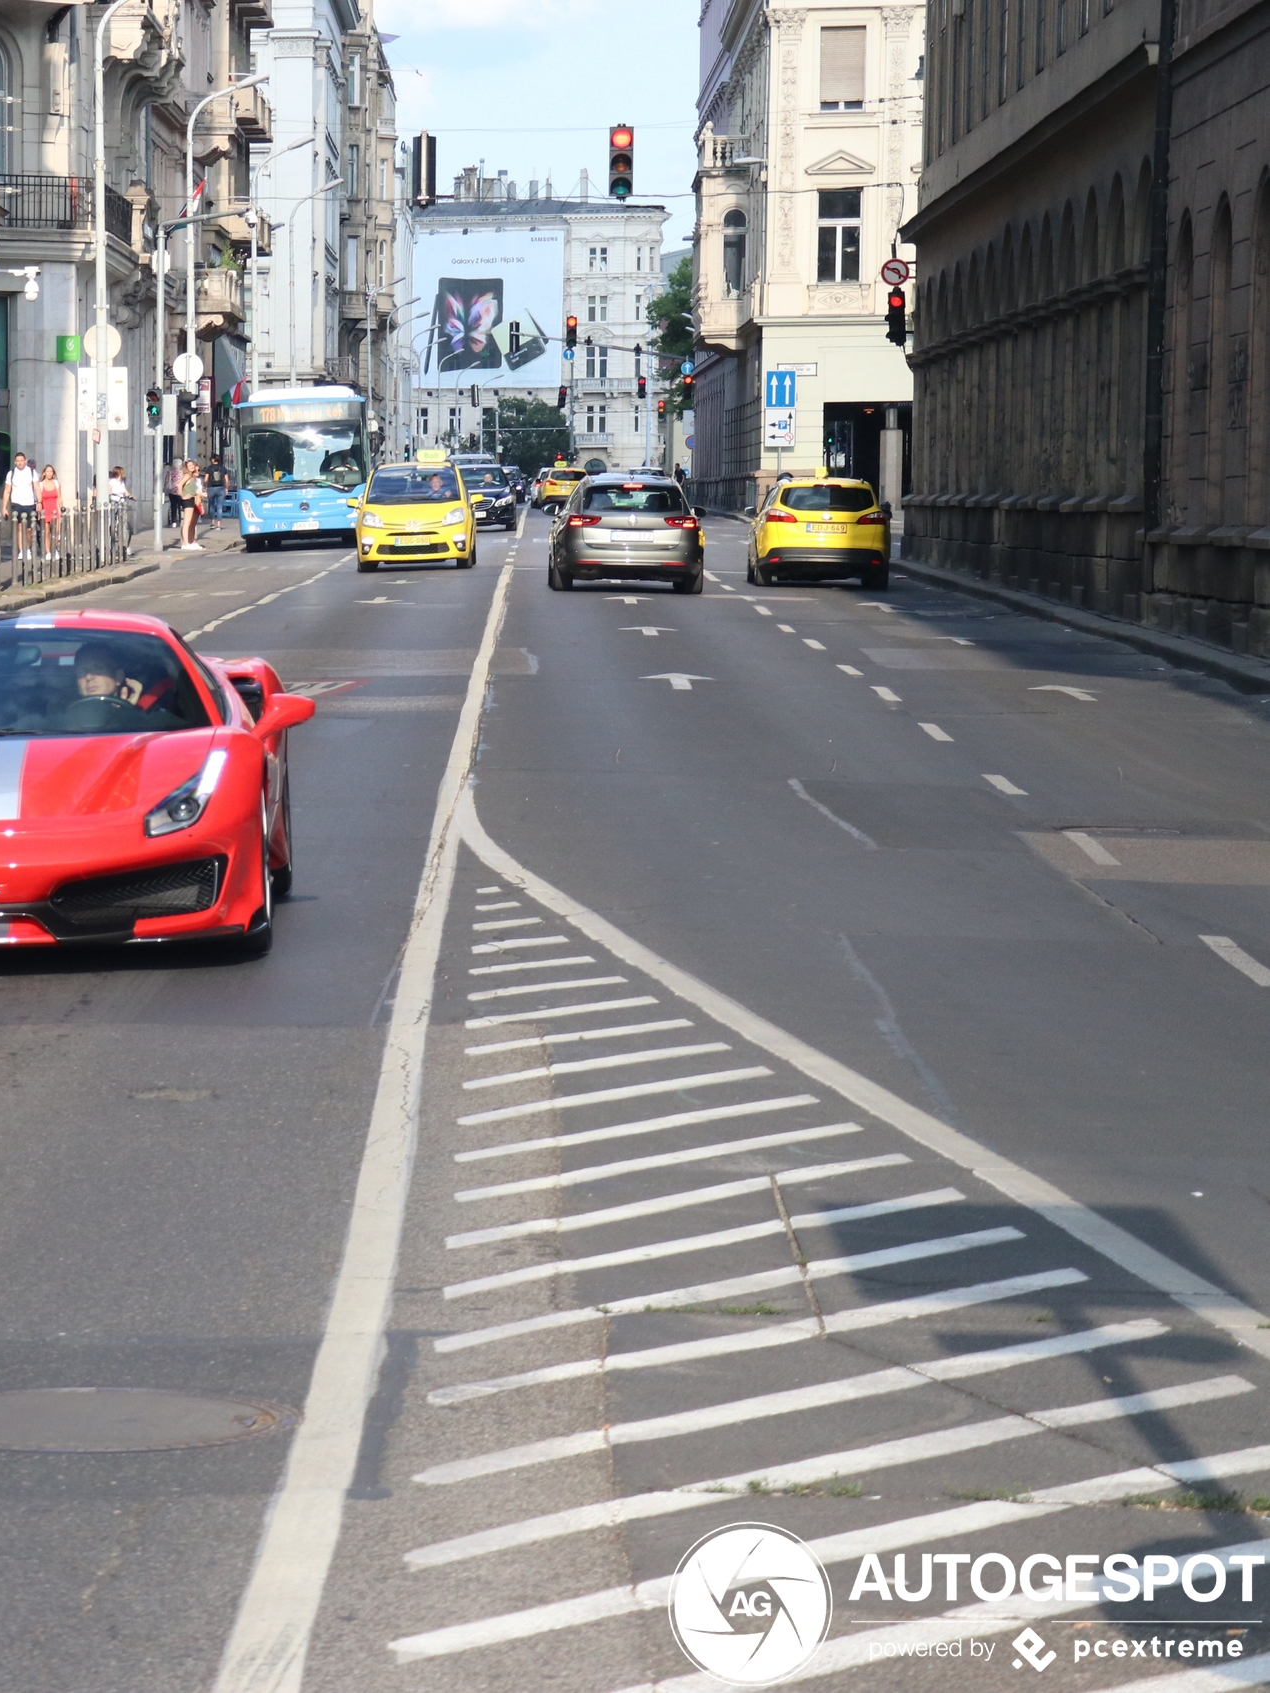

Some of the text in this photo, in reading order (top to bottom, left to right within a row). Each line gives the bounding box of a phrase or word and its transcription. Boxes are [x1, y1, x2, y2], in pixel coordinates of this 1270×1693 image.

[451, 257, 474, 265] Galaxy
[500, 256, 515, 264] Flip3
[259, 407, 276, 422] 178
[423, 451, 440, 460] Bolt
